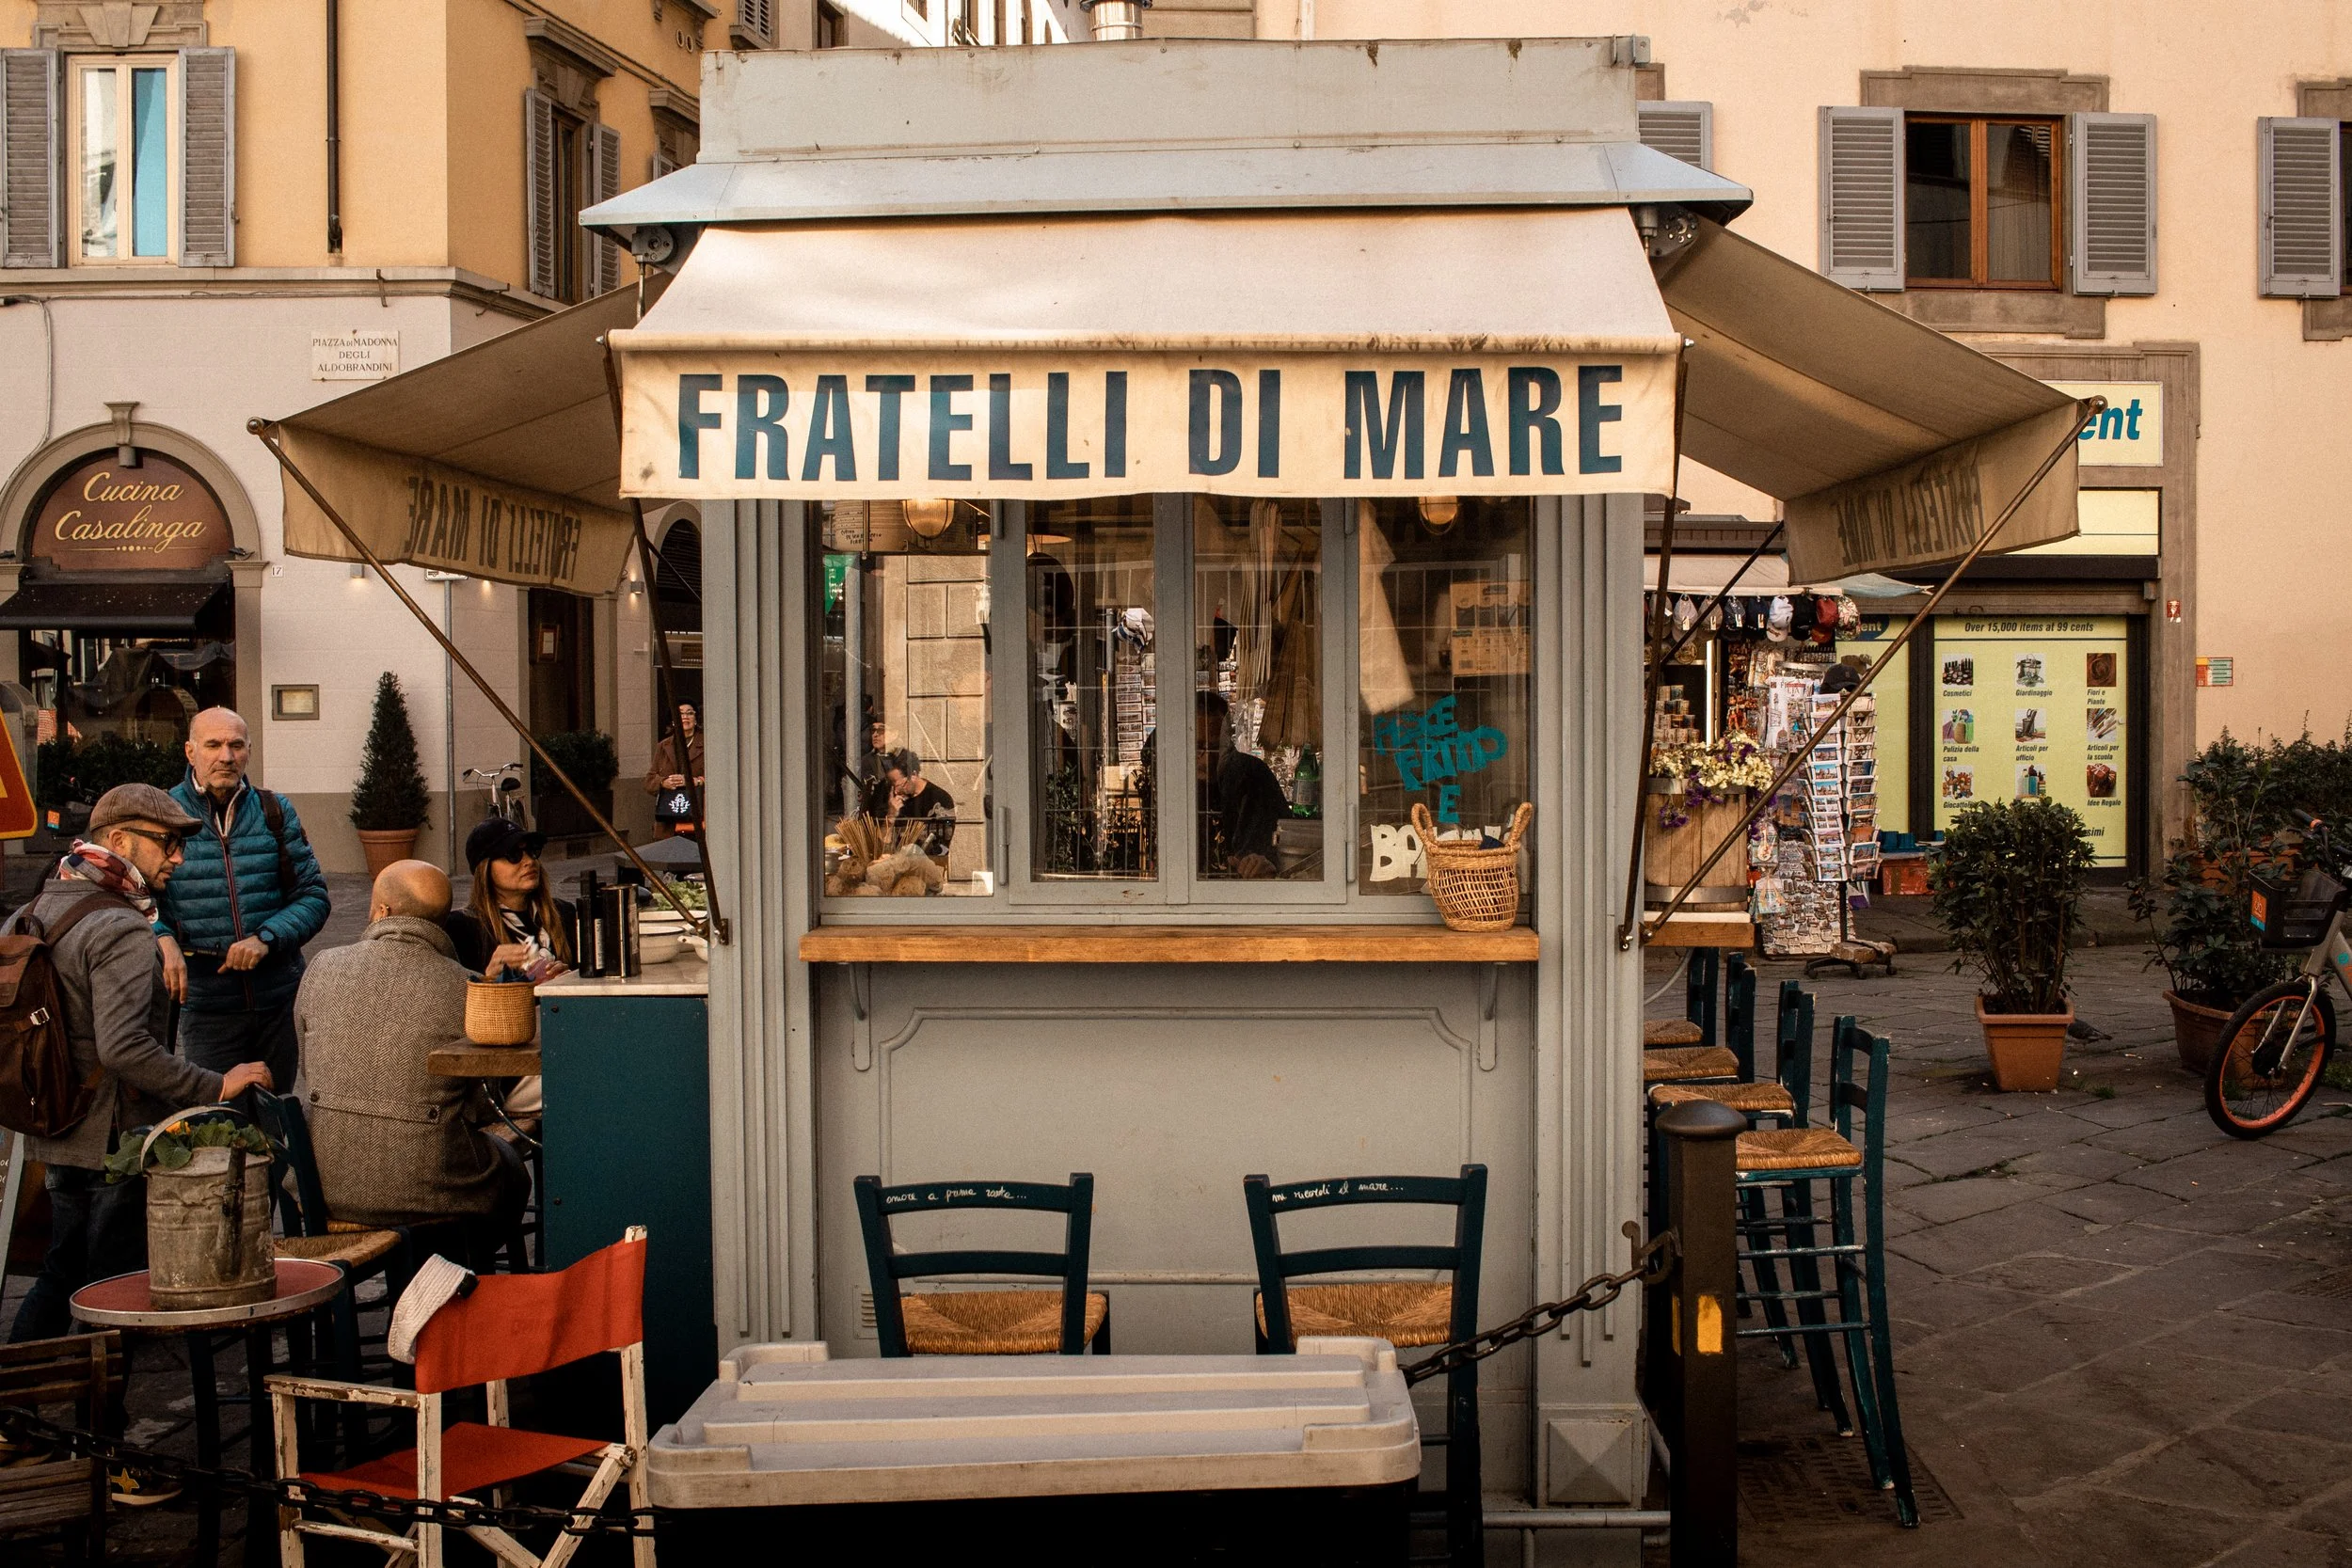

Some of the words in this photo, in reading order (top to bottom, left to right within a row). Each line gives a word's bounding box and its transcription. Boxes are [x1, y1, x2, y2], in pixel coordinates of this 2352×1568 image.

[312, 338, 345, 347] PIAZZA
[354, 338, 398, 347] MADONNA
[339, 351, 370, 359] DEGLI
[318, 363, 392, 372] ALDOBRANDINI
[678, 371, 1128, 482] FRATELLI
[1188, 369, 1280, 479] DI
[1344, 365, 1623, 480] MARE
[2077, 399, 2143, 440] ent
[83, 471, 184, 502] Cucina
[55, 504, 207, 554] Casalinga
[272, 566, 283, 576] 17
[1861, 621, 1882, 632] ent
[1964, 622, 1985, 632] Over
[1987, 622, 2017, 633] 15,000
[2019, 622, 2043, 632] items
[2045, 623, 2055, 632] at
[2057, 623, 2068, 632] 99
[2070, 622, 2094, 632] cents
[1943, 689, 1973, 697] Cosmetici
[2015, 689, 2053, 698] Giardinaggio
[2087, 697, 2106, 705] Piante
[1943, 745, 1963, 753] Pulizia
[2015, 744, 2038, 752] Articoli
[2109, 745, 2120, 753] per
[1394, 724, 1509, 792] FRITTO
[1438, 784, 1461, 824] E
[2101, 799, 2122, 807] Regalo
[2084, 827, 2105, 837] simi
[928, 1193, 939, 1201] a
